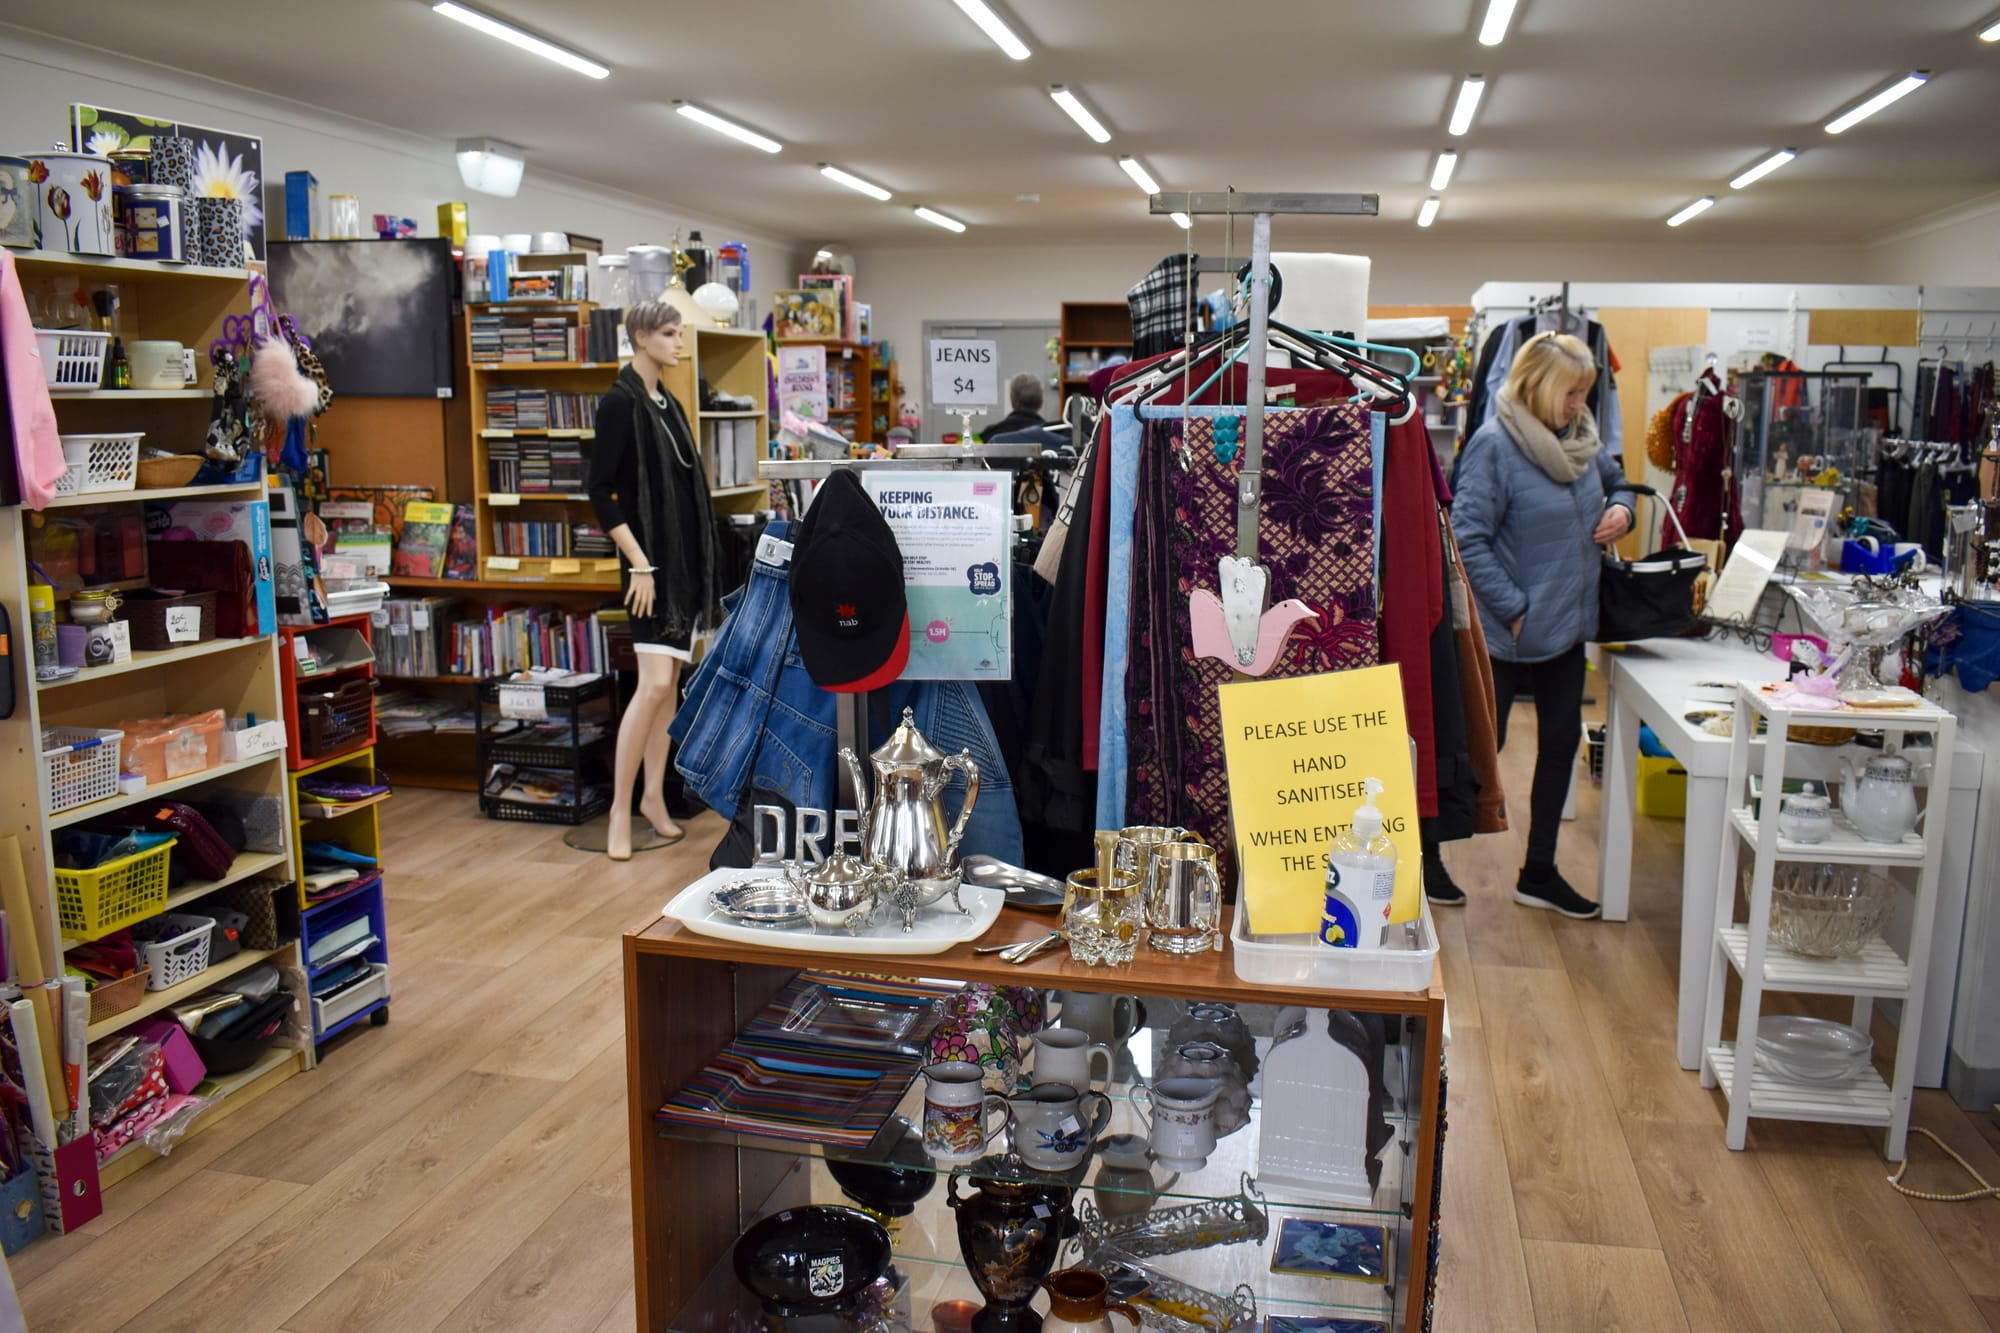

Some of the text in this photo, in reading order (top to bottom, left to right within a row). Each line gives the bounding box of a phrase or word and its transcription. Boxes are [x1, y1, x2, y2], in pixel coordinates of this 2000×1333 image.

[936, 347, 991, 363] JEANS
[953, 376, 975, 395] $4
[880, 491, 933, 504] KEEPING
[880, 506, 979, 520] YOUR DISTANCE.
[974, 572, 993, 581] STOP
[839, 618, 859, 627] nab
[1244, 710, 1388, 741] PLEASE USE THE
[1293, 754, 1347, 774] HAND
[1250, 816, 1406, 847] WHEN ENTNG
[1280, 855, 1316, 872] THE
[811, 1256, 841, 1267] MAGPIES
